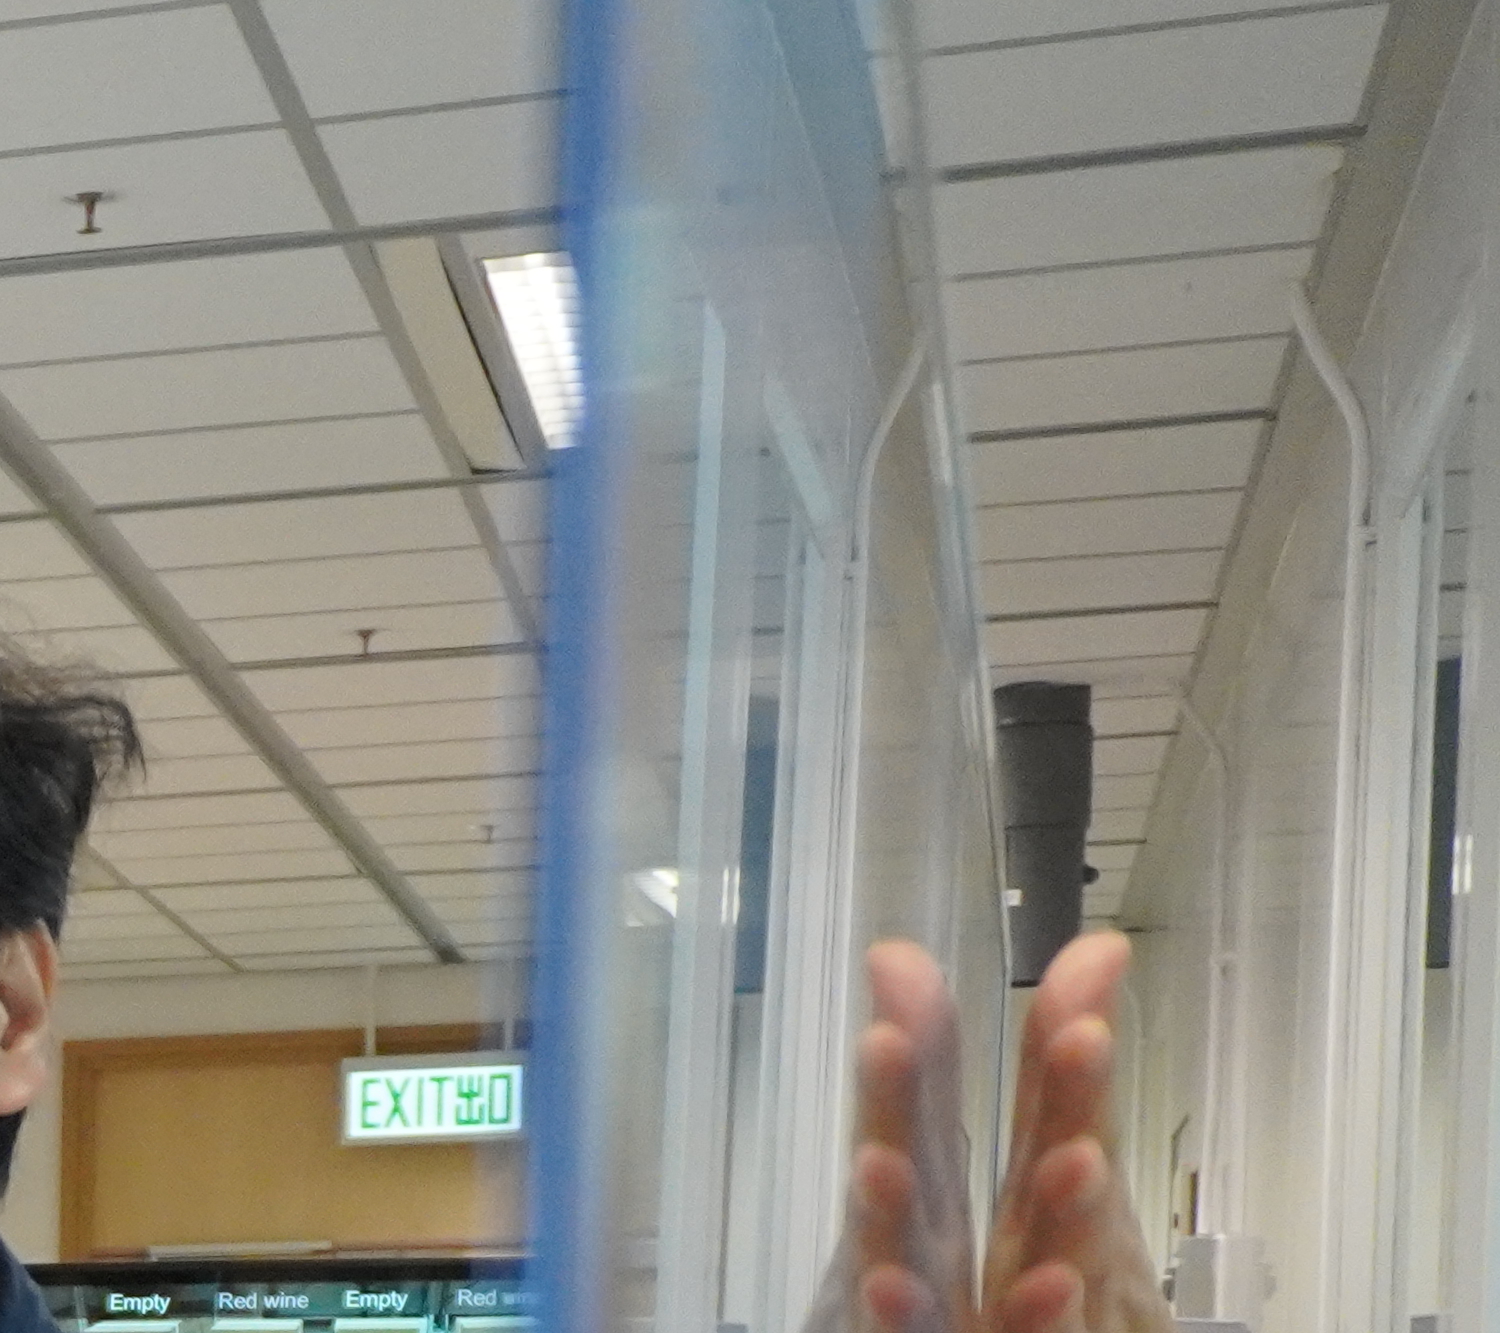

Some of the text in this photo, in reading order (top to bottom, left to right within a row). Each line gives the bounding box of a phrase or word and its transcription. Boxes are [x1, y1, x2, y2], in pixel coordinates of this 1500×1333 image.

[361, 1073, 513, 1129] EXIT 出口
[108, 1293, 171, 1315] Empty
[218, 1291, 257, 1309] Red
[264, 1291, 309, 1309] wine
[345, 1290, 408, 1311] Empty
[458, 1289, 497, 1306] Red
